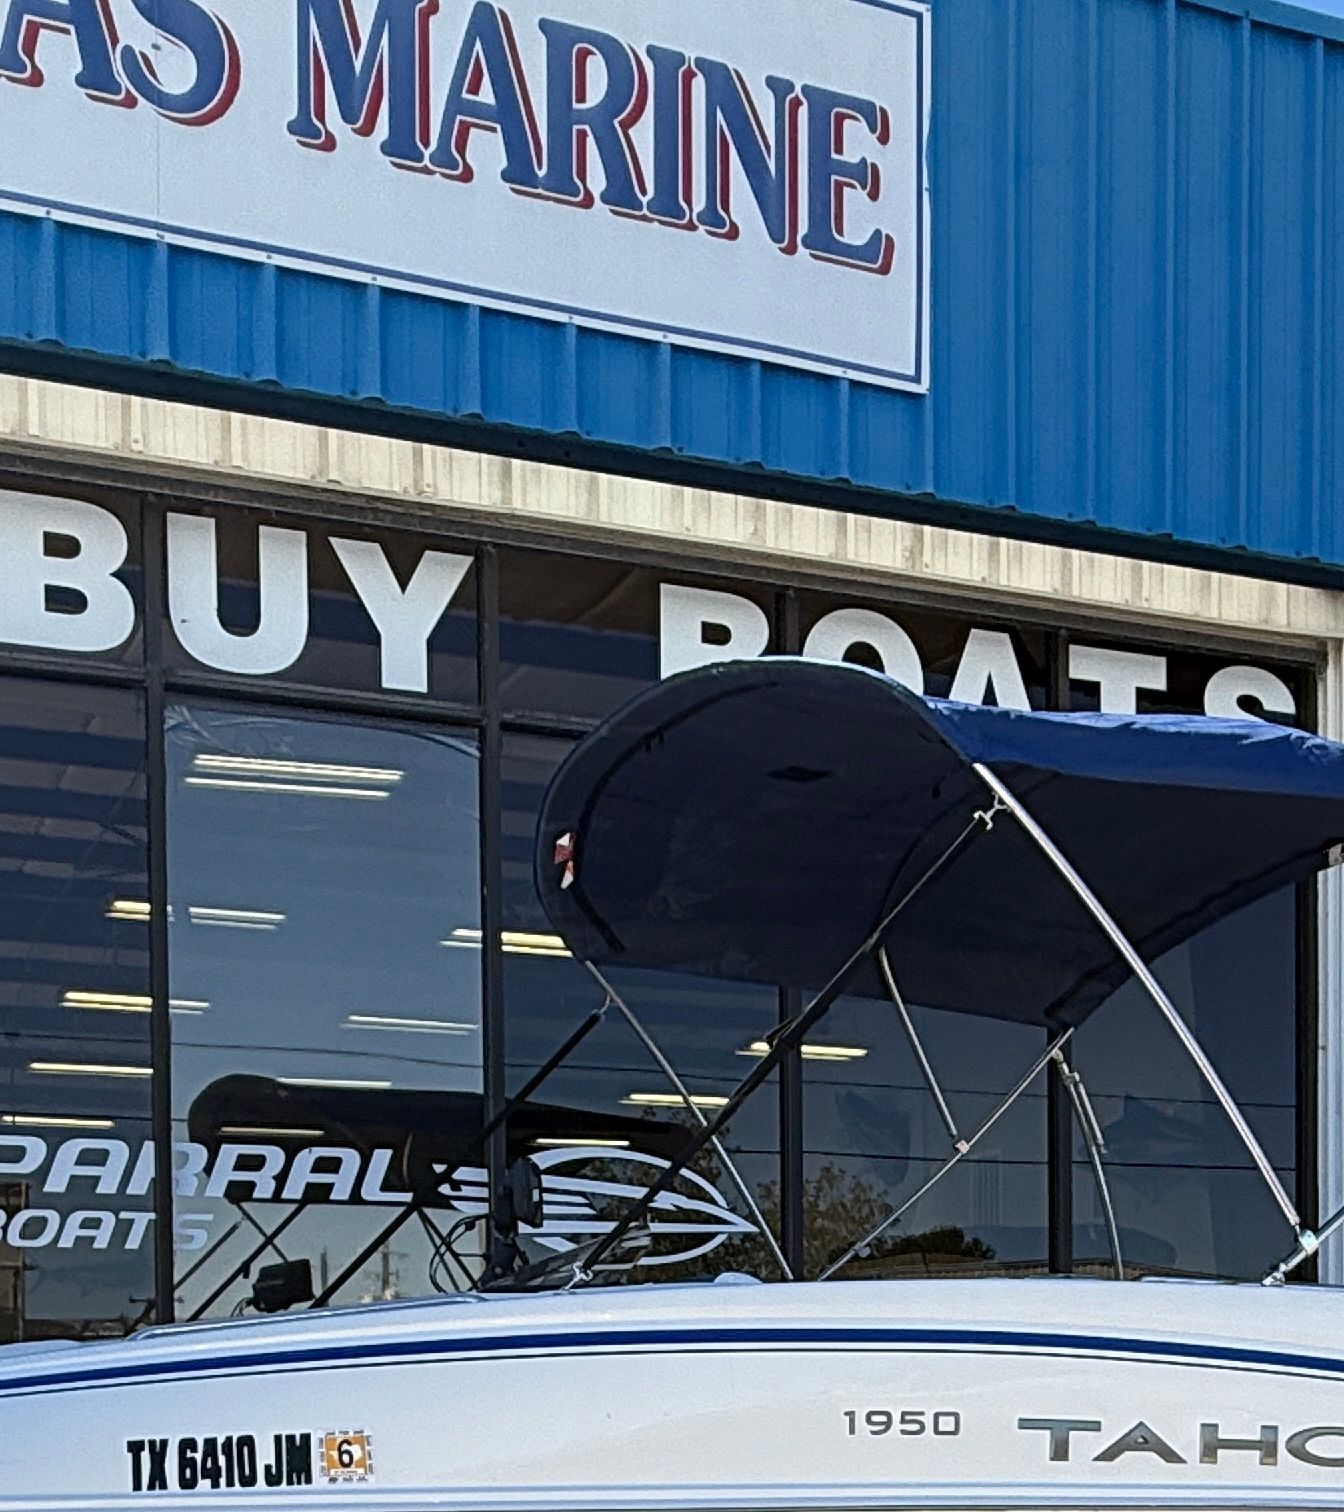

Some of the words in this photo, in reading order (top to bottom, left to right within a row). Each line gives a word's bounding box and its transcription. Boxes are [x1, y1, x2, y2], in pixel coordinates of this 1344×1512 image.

[286, 0, 895, 276] MARINE
[843, 1409, 961, 1436] 1950
[126, 1437, 169, 1492] TX
[177, 1435, 256, 1489] 6410
[263, 1433, 313, 1487] JM
[337, 1438, 354, 1468] 6
